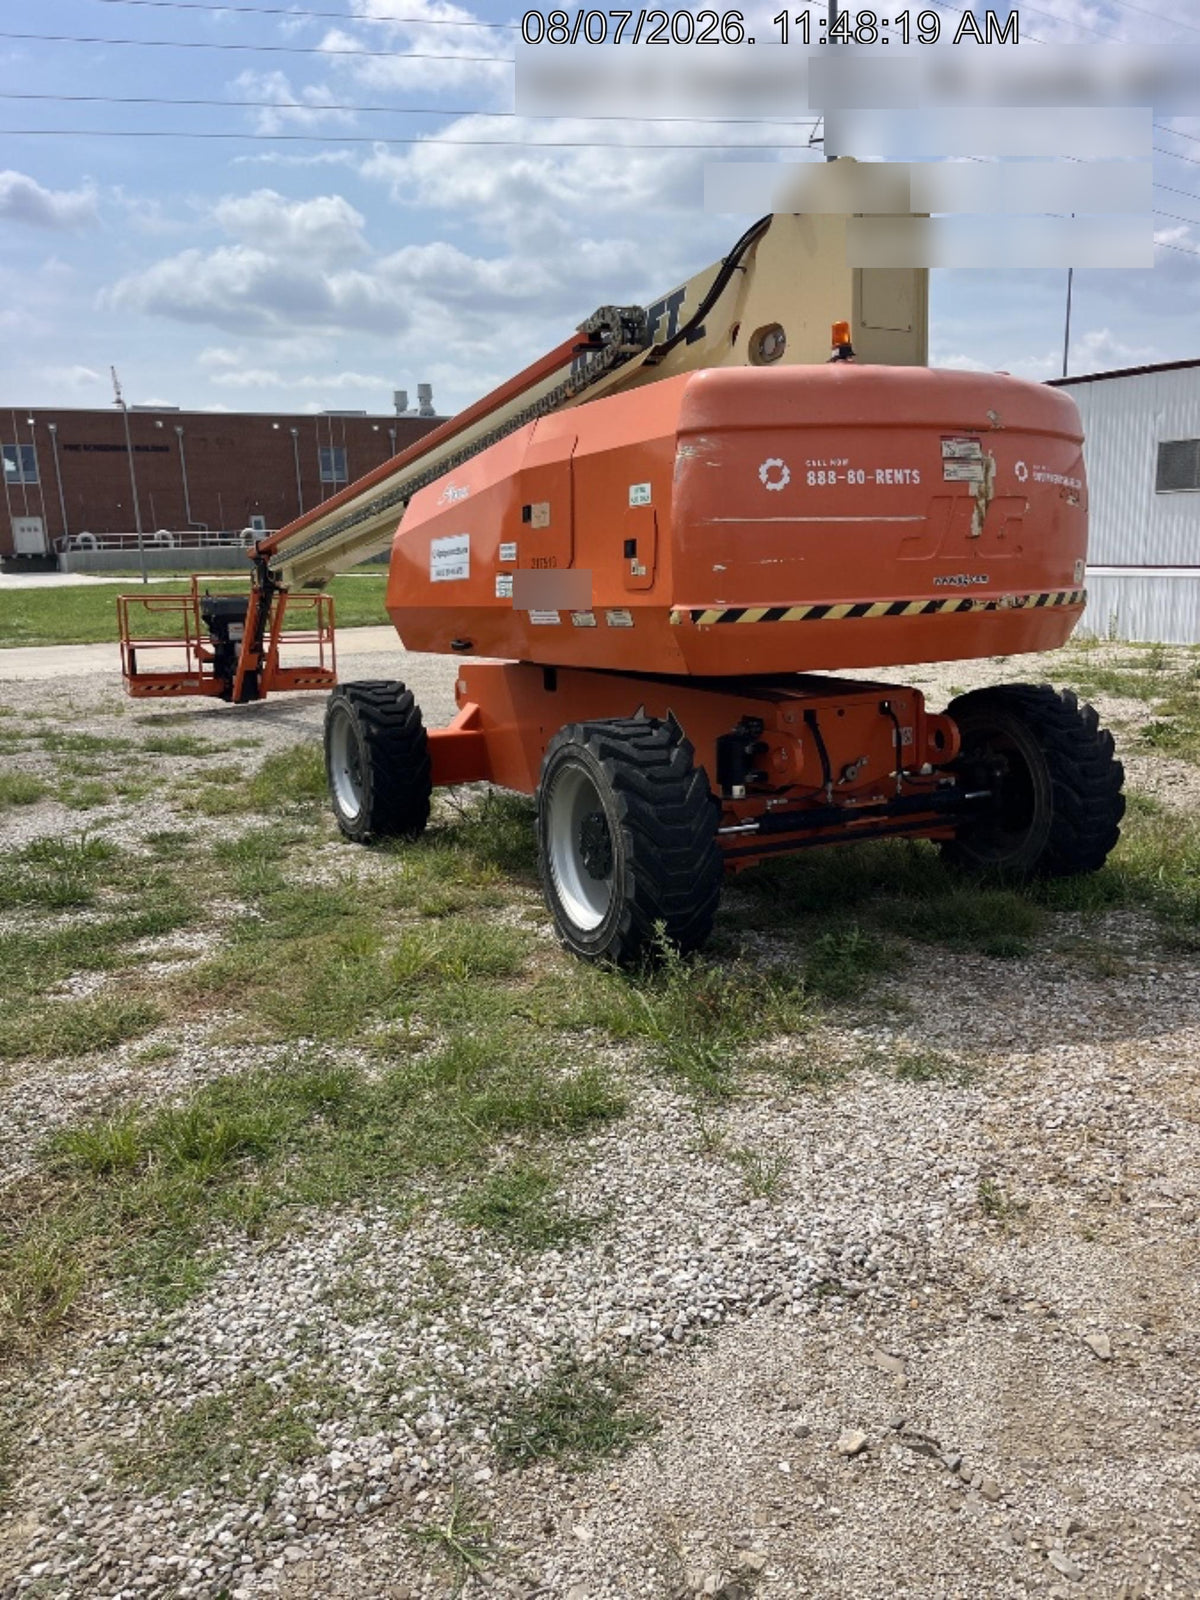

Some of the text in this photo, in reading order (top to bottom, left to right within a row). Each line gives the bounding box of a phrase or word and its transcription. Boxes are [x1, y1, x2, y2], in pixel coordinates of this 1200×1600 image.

[805, 458, 849, 467] CALL NOW
[807, 469, 920, 486] 888-80-RENTS
